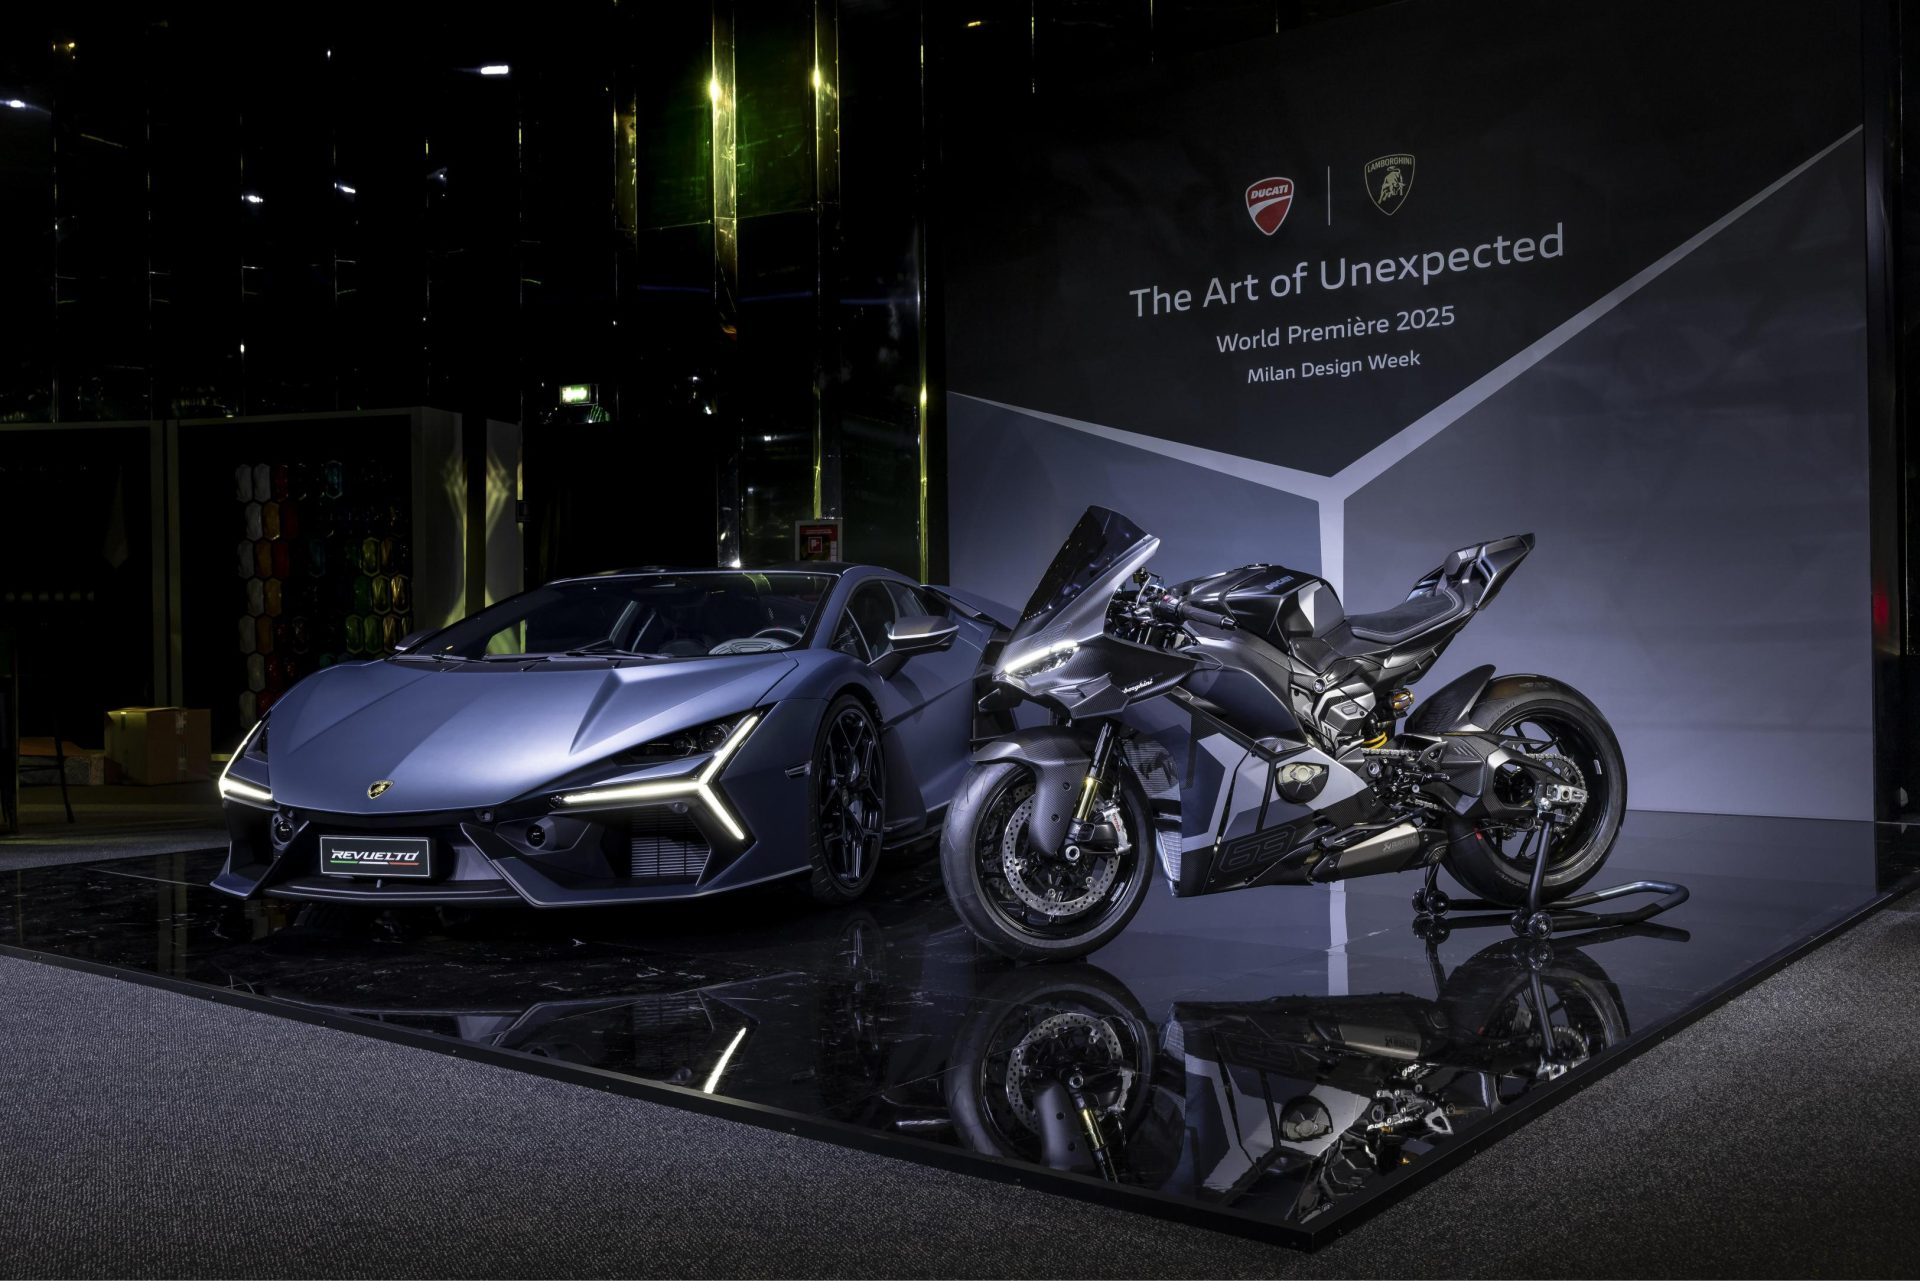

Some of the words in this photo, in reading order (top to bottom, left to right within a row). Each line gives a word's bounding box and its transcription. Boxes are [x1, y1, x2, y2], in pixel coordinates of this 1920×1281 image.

[1367, 156, 1412, 173] LAMBORGHINI
[1250, 184, 1289, 200] DUCATI
[1129, 286, 1192, 318] The
[1202, 274, 1259, 308] Art
[1270, 261, 1308, 298] of
[1320, 221, 1564, 290] Unexpected
[1216, 326, 1280, 353] World
[1288, 316, 1390, 345] Première
[1396, 305, 1455, 332] 2025
[1247, 365, 1296, 384] Milan
[1301, 358, 1363, 378] Design
[1367, 349, 1421, 371] Week
[331, 848, 420, 861] REVUELTO
